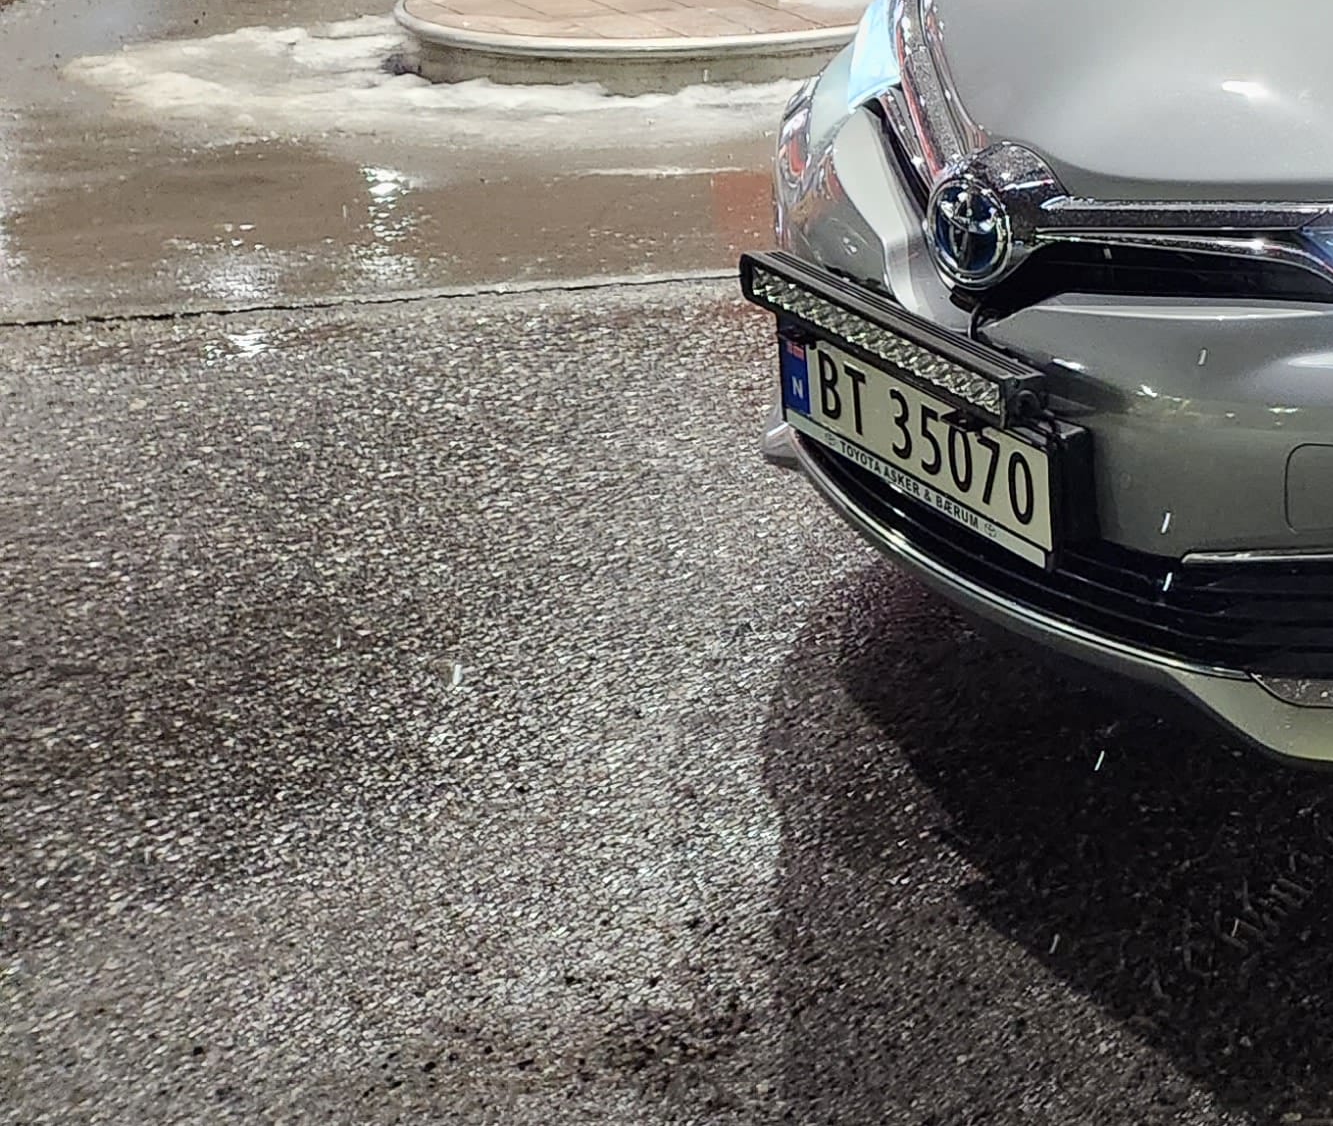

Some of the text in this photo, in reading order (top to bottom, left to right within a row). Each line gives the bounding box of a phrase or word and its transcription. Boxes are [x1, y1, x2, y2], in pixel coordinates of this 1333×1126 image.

[791, 379, 805, 399] N
[818, 349, 1035, 525] BT 35070
[840, 440, 980, 530] TOYOTA ASKER & BÆRUM
